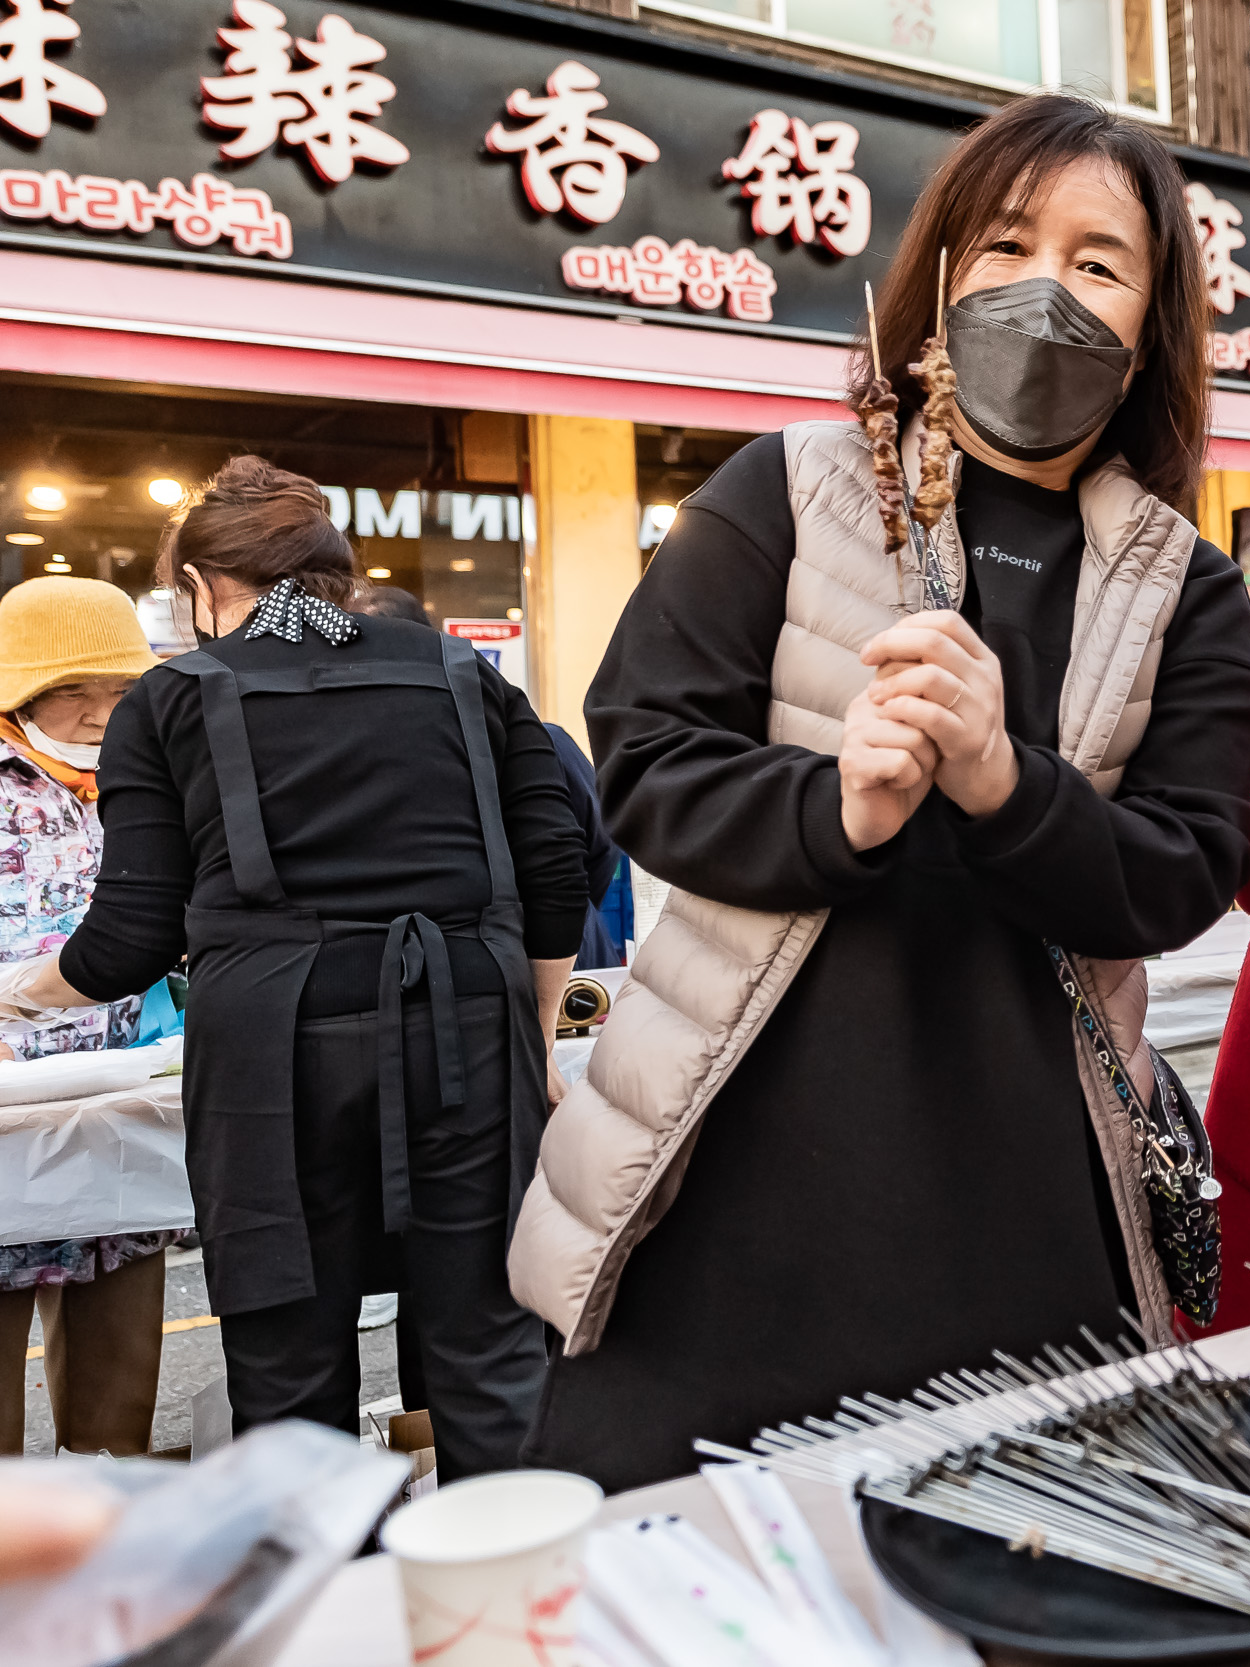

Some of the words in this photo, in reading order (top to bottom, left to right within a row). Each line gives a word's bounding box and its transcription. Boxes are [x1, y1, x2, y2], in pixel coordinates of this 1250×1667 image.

[0, 169, 293, 260] 마라샹궈
[561, 235, 778, 323] 매운향솥
[988, 545, 1043, 573] Sportif
